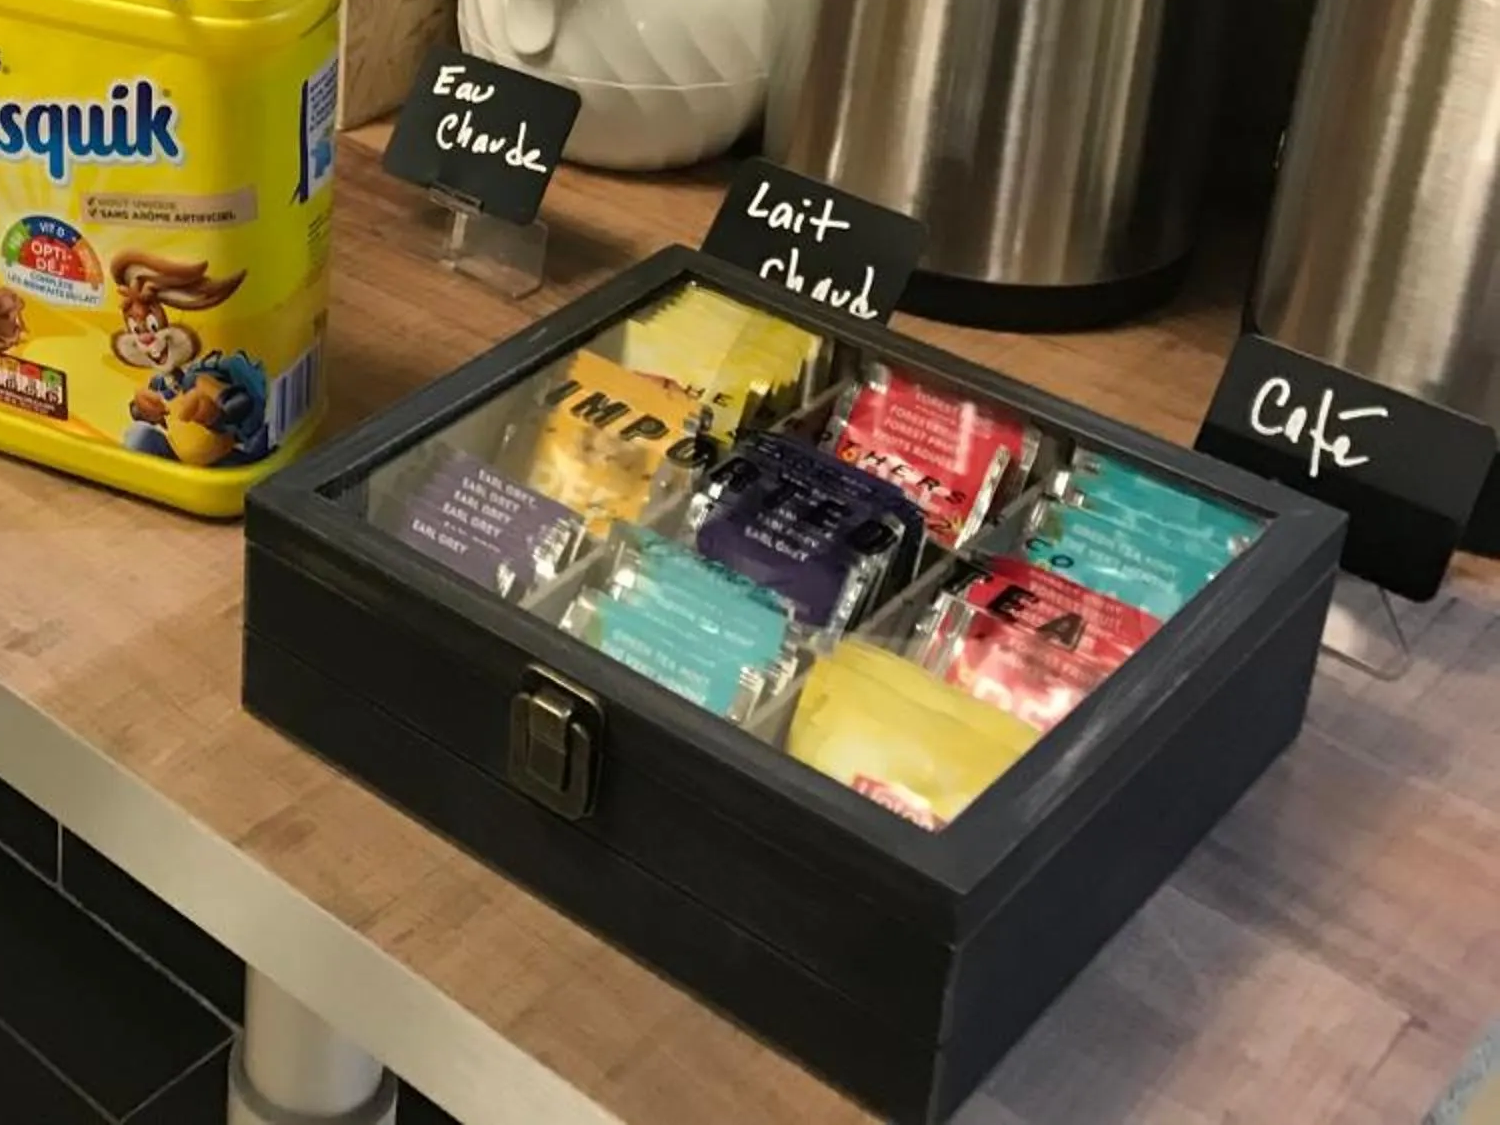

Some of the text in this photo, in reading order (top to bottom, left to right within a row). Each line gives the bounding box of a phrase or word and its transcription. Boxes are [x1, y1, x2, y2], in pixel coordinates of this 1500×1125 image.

[433, 65, 495, 104] Eau
[436, 111, 547, 174] Chaude
[747, 181, 851, 242] Lait
[411, 518, 436, 540] EARL
[438, 532, 469, 555] GREY
